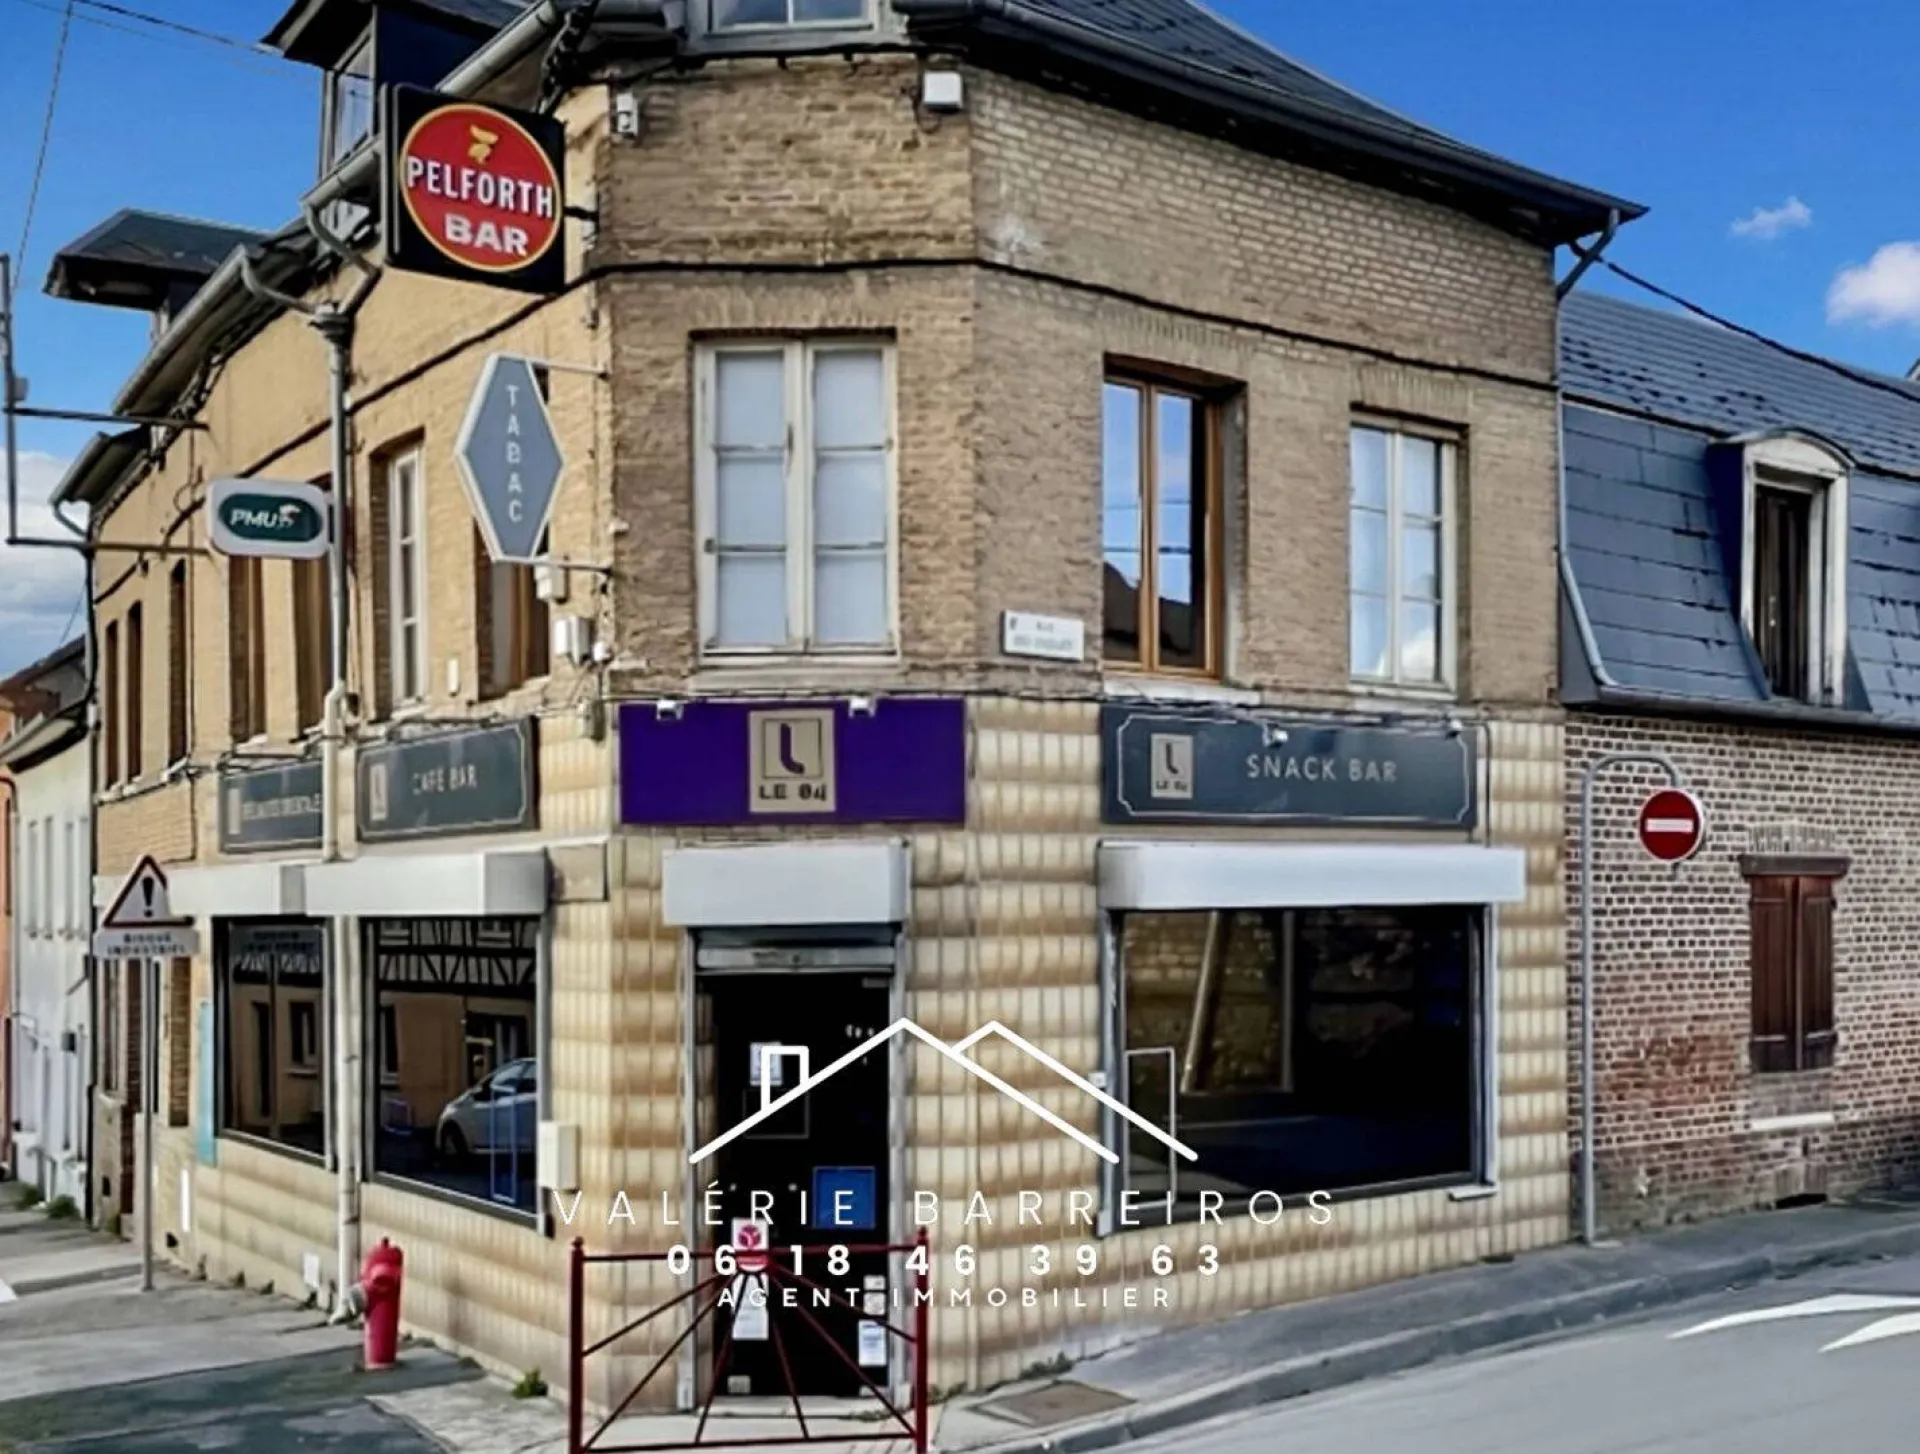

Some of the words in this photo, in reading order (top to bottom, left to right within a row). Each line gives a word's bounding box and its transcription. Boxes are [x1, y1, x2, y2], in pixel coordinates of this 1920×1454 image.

[406, 156, 553, 219] PELFORTH
[443, 213, 529, 257] BAR
[506, 384, 524, 523] TABAC
[229, 508, 278, 528] PMU
[1246, 753, 1338, 782] SNACK
[1348, 758, 1399, 783] BAR
[758, 783, 788, 800] LE
